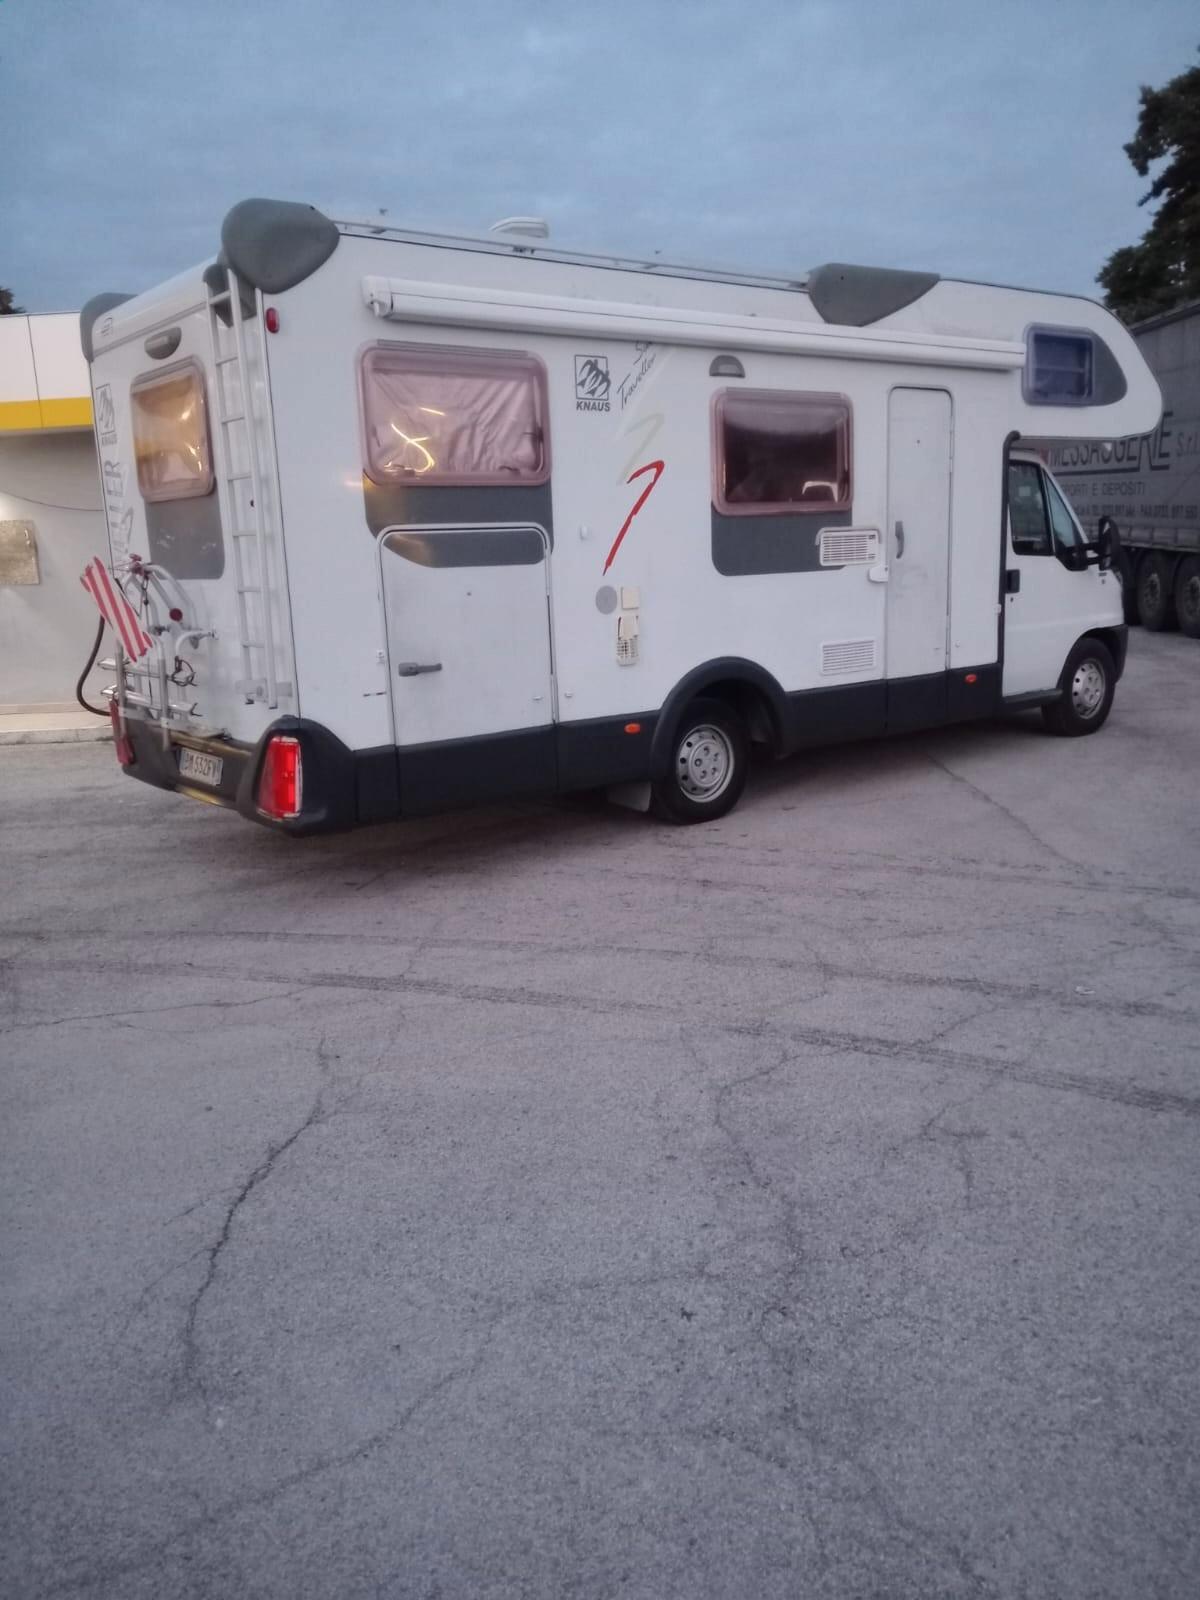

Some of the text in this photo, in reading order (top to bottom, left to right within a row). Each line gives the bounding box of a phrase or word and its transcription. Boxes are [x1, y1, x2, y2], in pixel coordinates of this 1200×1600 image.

[575, 400, 611, 412] KNAUS
[1092, 482, 1099, 497] E
[1102, 481, 1145, 496] DEPOSITI
